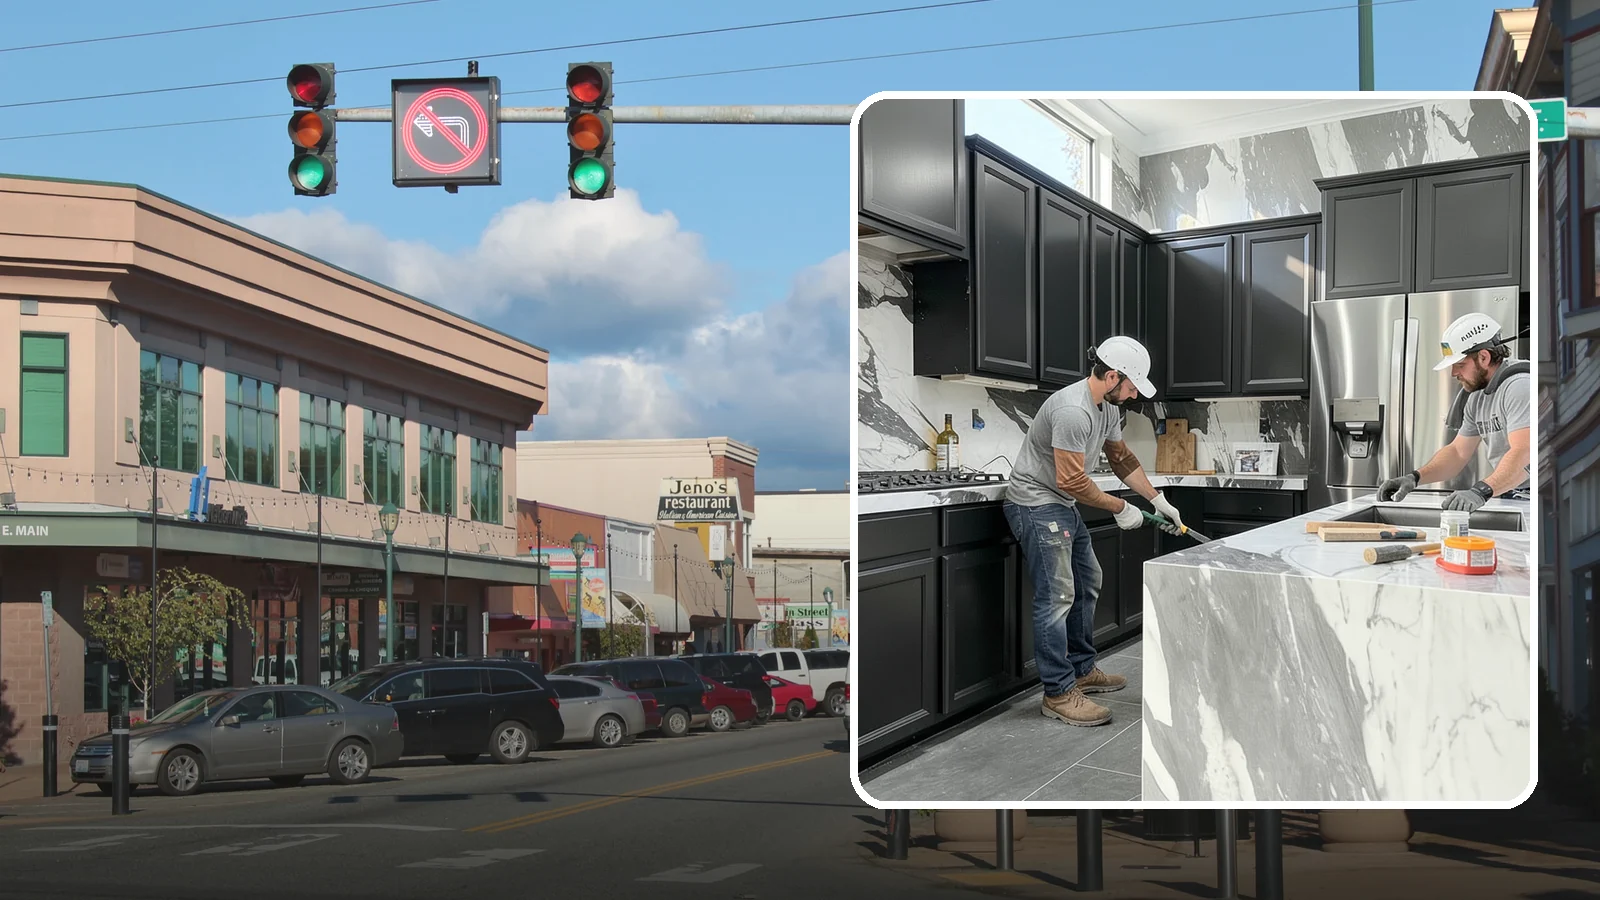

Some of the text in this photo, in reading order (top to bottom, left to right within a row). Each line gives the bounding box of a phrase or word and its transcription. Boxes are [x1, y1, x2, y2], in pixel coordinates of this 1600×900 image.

[670, 480, 727, 494] Jeno's
[665, 496, 731, 509] restaurant
[686, 510, 714, 519] American
[715, 509, 737, 519] Cuisine
[2, 525, 49, 536] E. MAIN
[797, 607, 829, 617] Street
